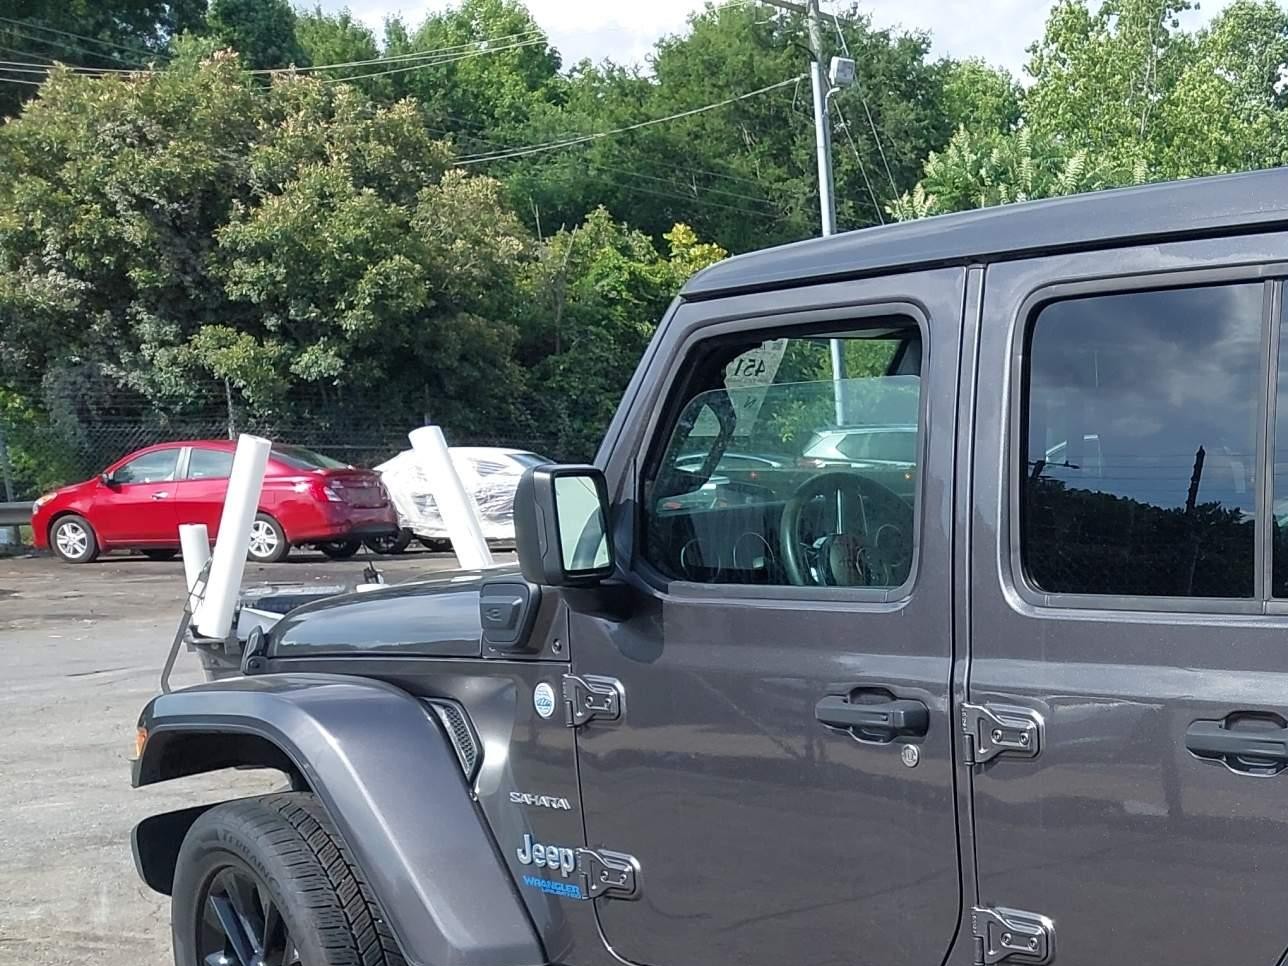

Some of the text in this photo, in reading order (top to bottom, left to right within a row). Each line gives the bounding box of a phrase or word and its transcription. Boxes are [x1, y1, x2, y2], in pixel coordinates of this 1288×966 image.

[509, 791, 572, 810] SAHARA
[516, 833, 575, 878] Jeep
[522, 874, 581, 896] WRANGLER
